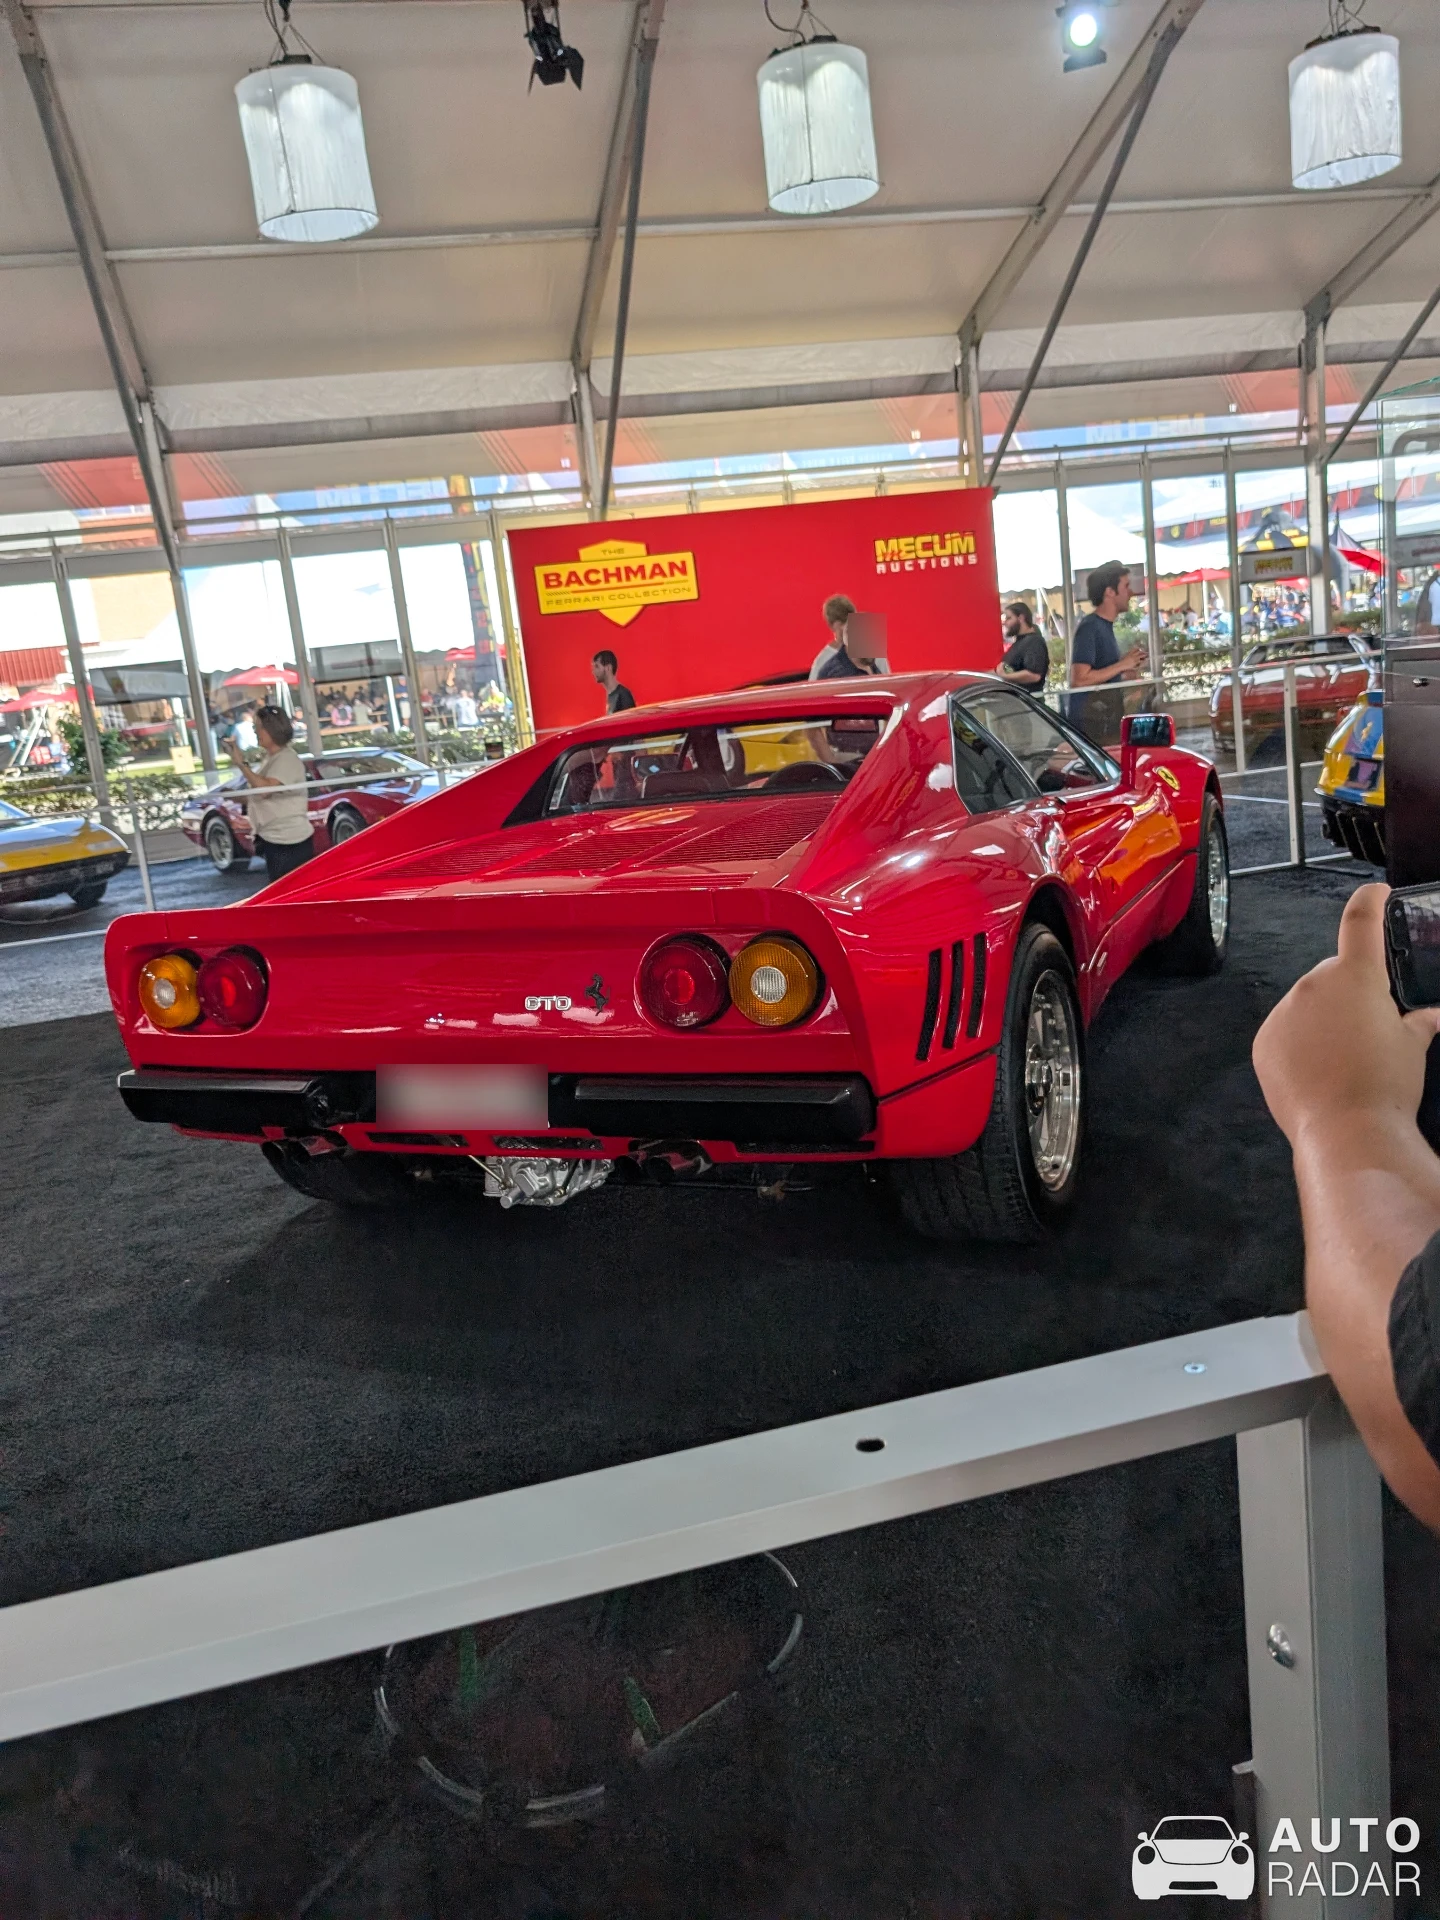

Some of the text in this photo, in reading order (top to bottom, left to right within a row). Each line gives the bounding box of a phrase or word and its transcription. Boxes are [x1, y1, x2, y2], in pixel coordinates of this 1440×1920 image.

[600, 547, 625, 556] THE
[874, 531, 976, 562] MECUM
[876, 554, 978, 575] AUCTIONS
[543, 560, 688, 590] BACHMAN
[545, 587, 692, 607] FERRARI COLLECTION
[525, 996, 572, 1011] GTO
